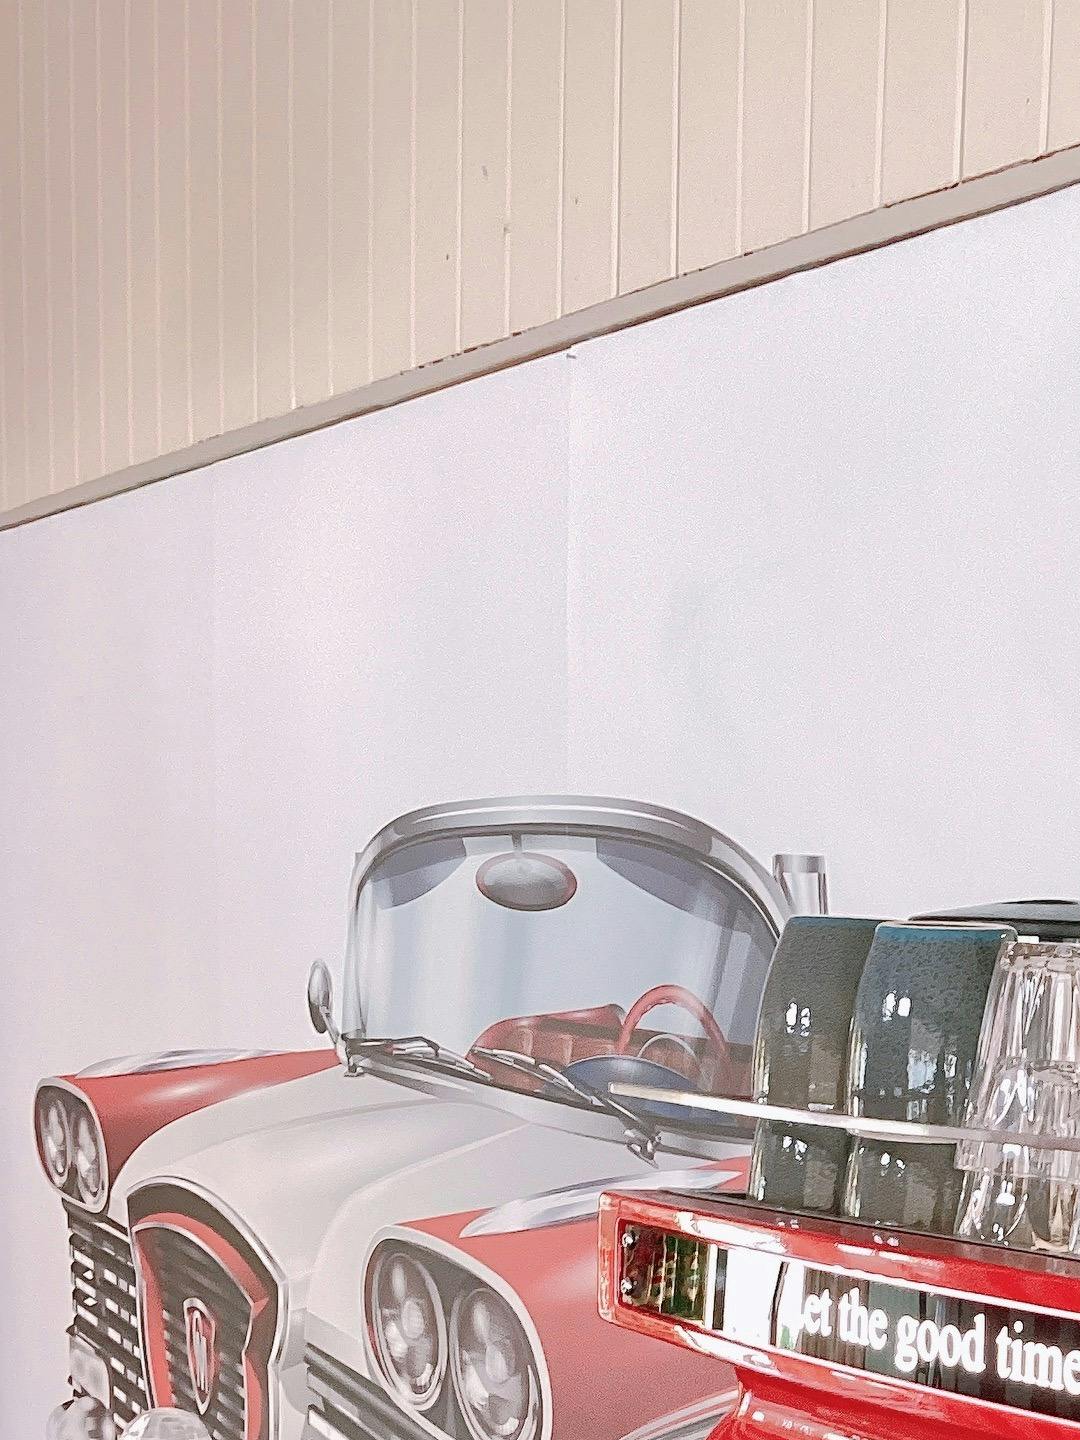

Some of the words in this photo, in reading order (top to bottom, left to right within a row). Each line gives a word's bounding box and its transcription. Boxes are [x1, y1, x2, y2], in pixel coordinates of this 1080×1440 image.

[785, 1288, 832, 1338] et
[838, 1287, 889, 1351] the
[894, 1312, 987, 1374] good
